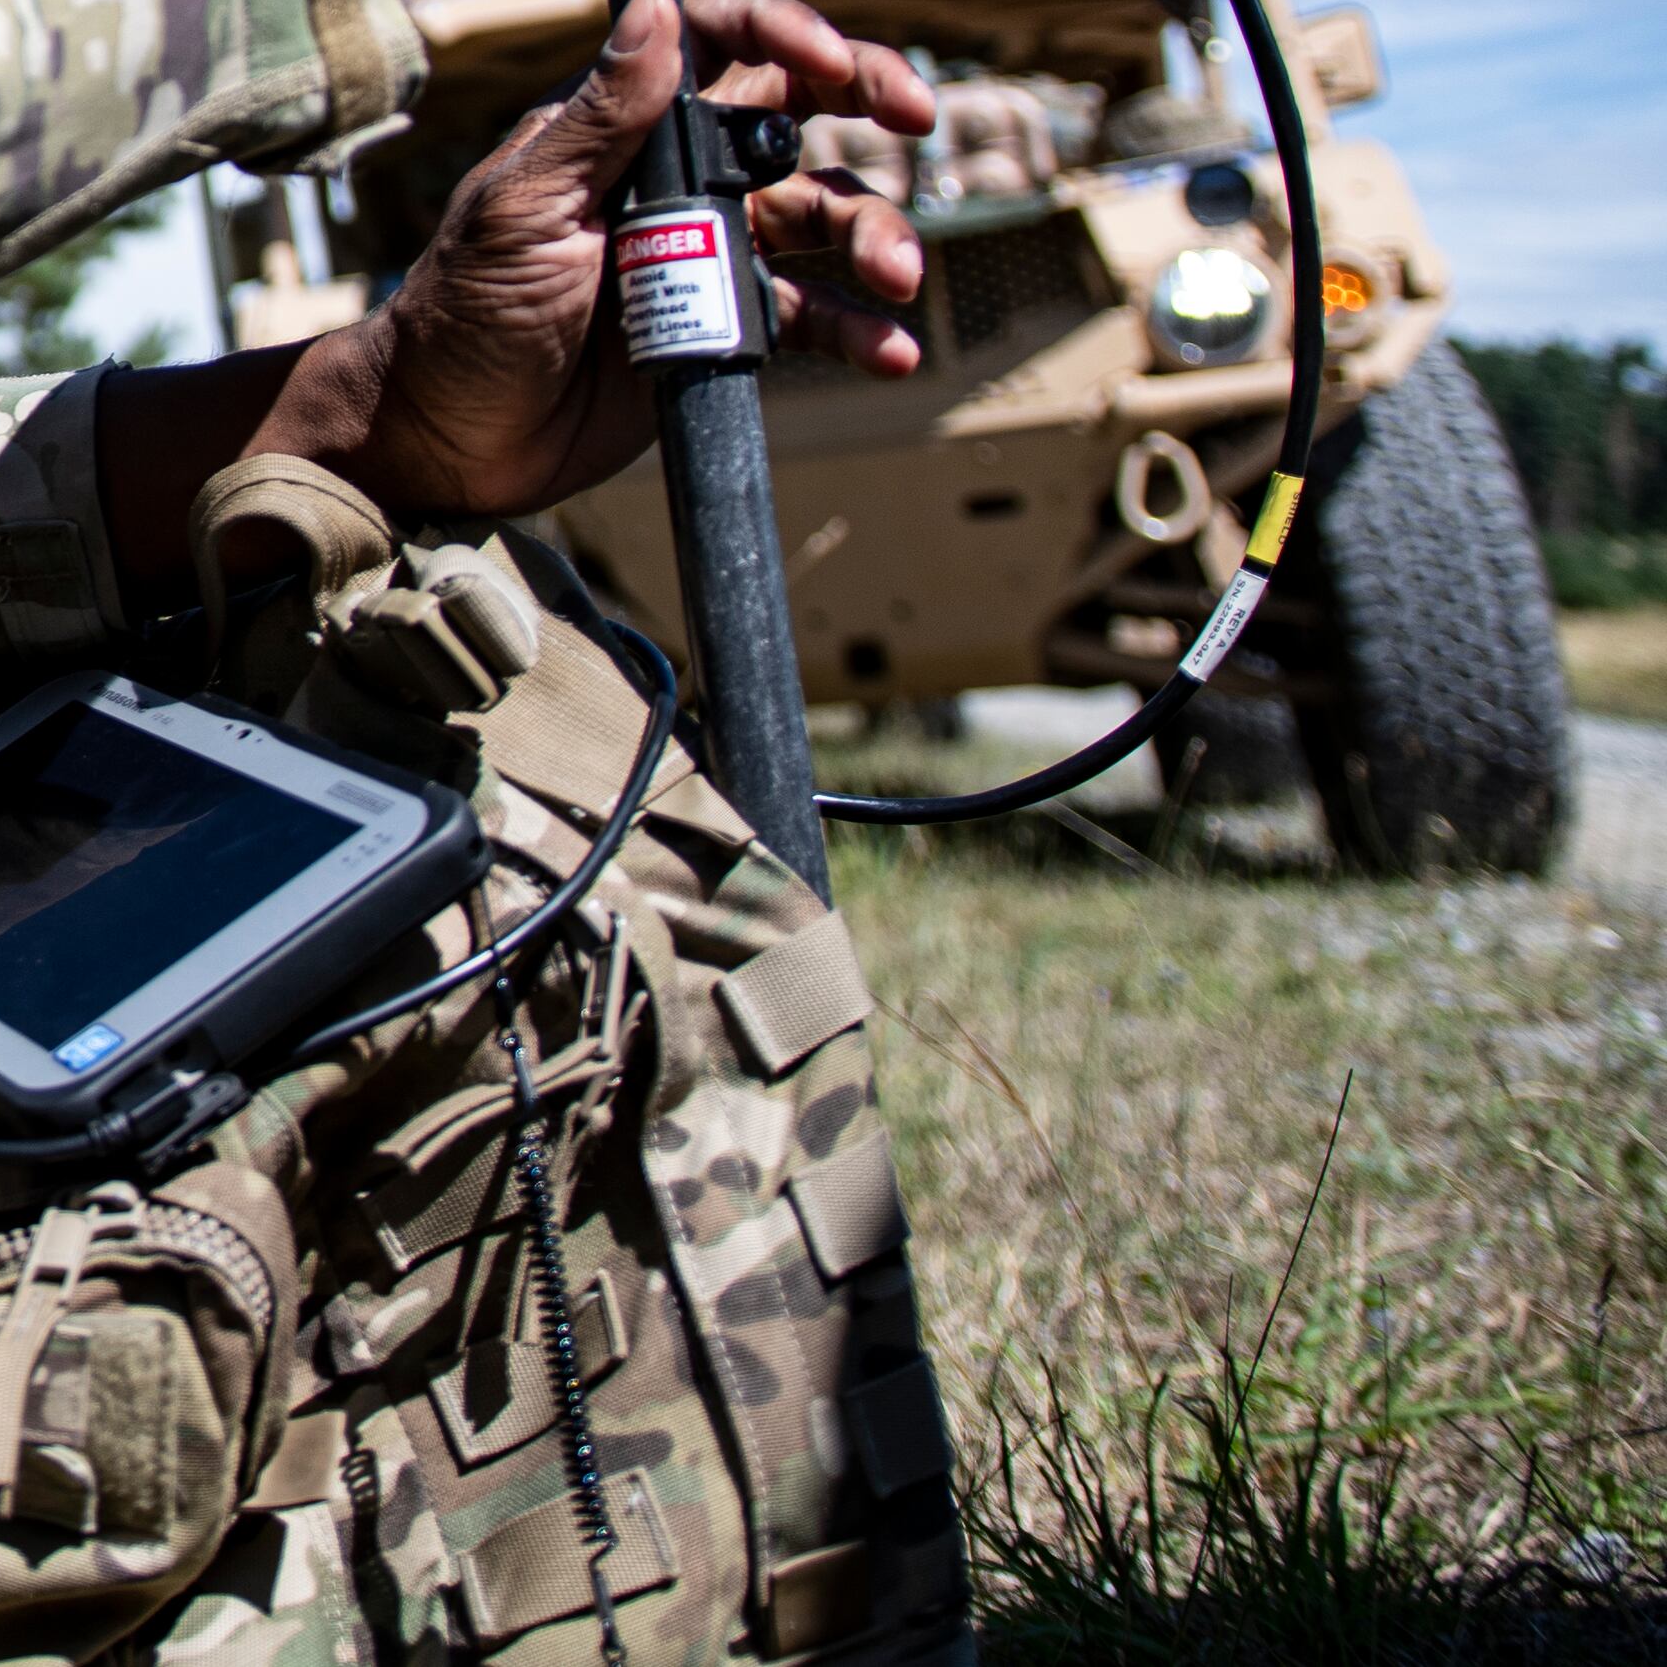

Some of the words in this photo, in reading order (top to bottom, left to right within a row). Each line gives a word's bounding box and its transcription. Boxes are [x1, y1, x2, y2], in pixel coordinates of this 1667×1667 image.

[616, 228, 705, 265] DANGER
[629, 269, 666, 287] Avoid
[663, 282, 700, 297] With
[658, 319, 702, 334] Lines
[1226, 608, 1246, 637] REV
[1216, 638, 1227, 649] A
[88, 681, 149, 715] Panasonic
